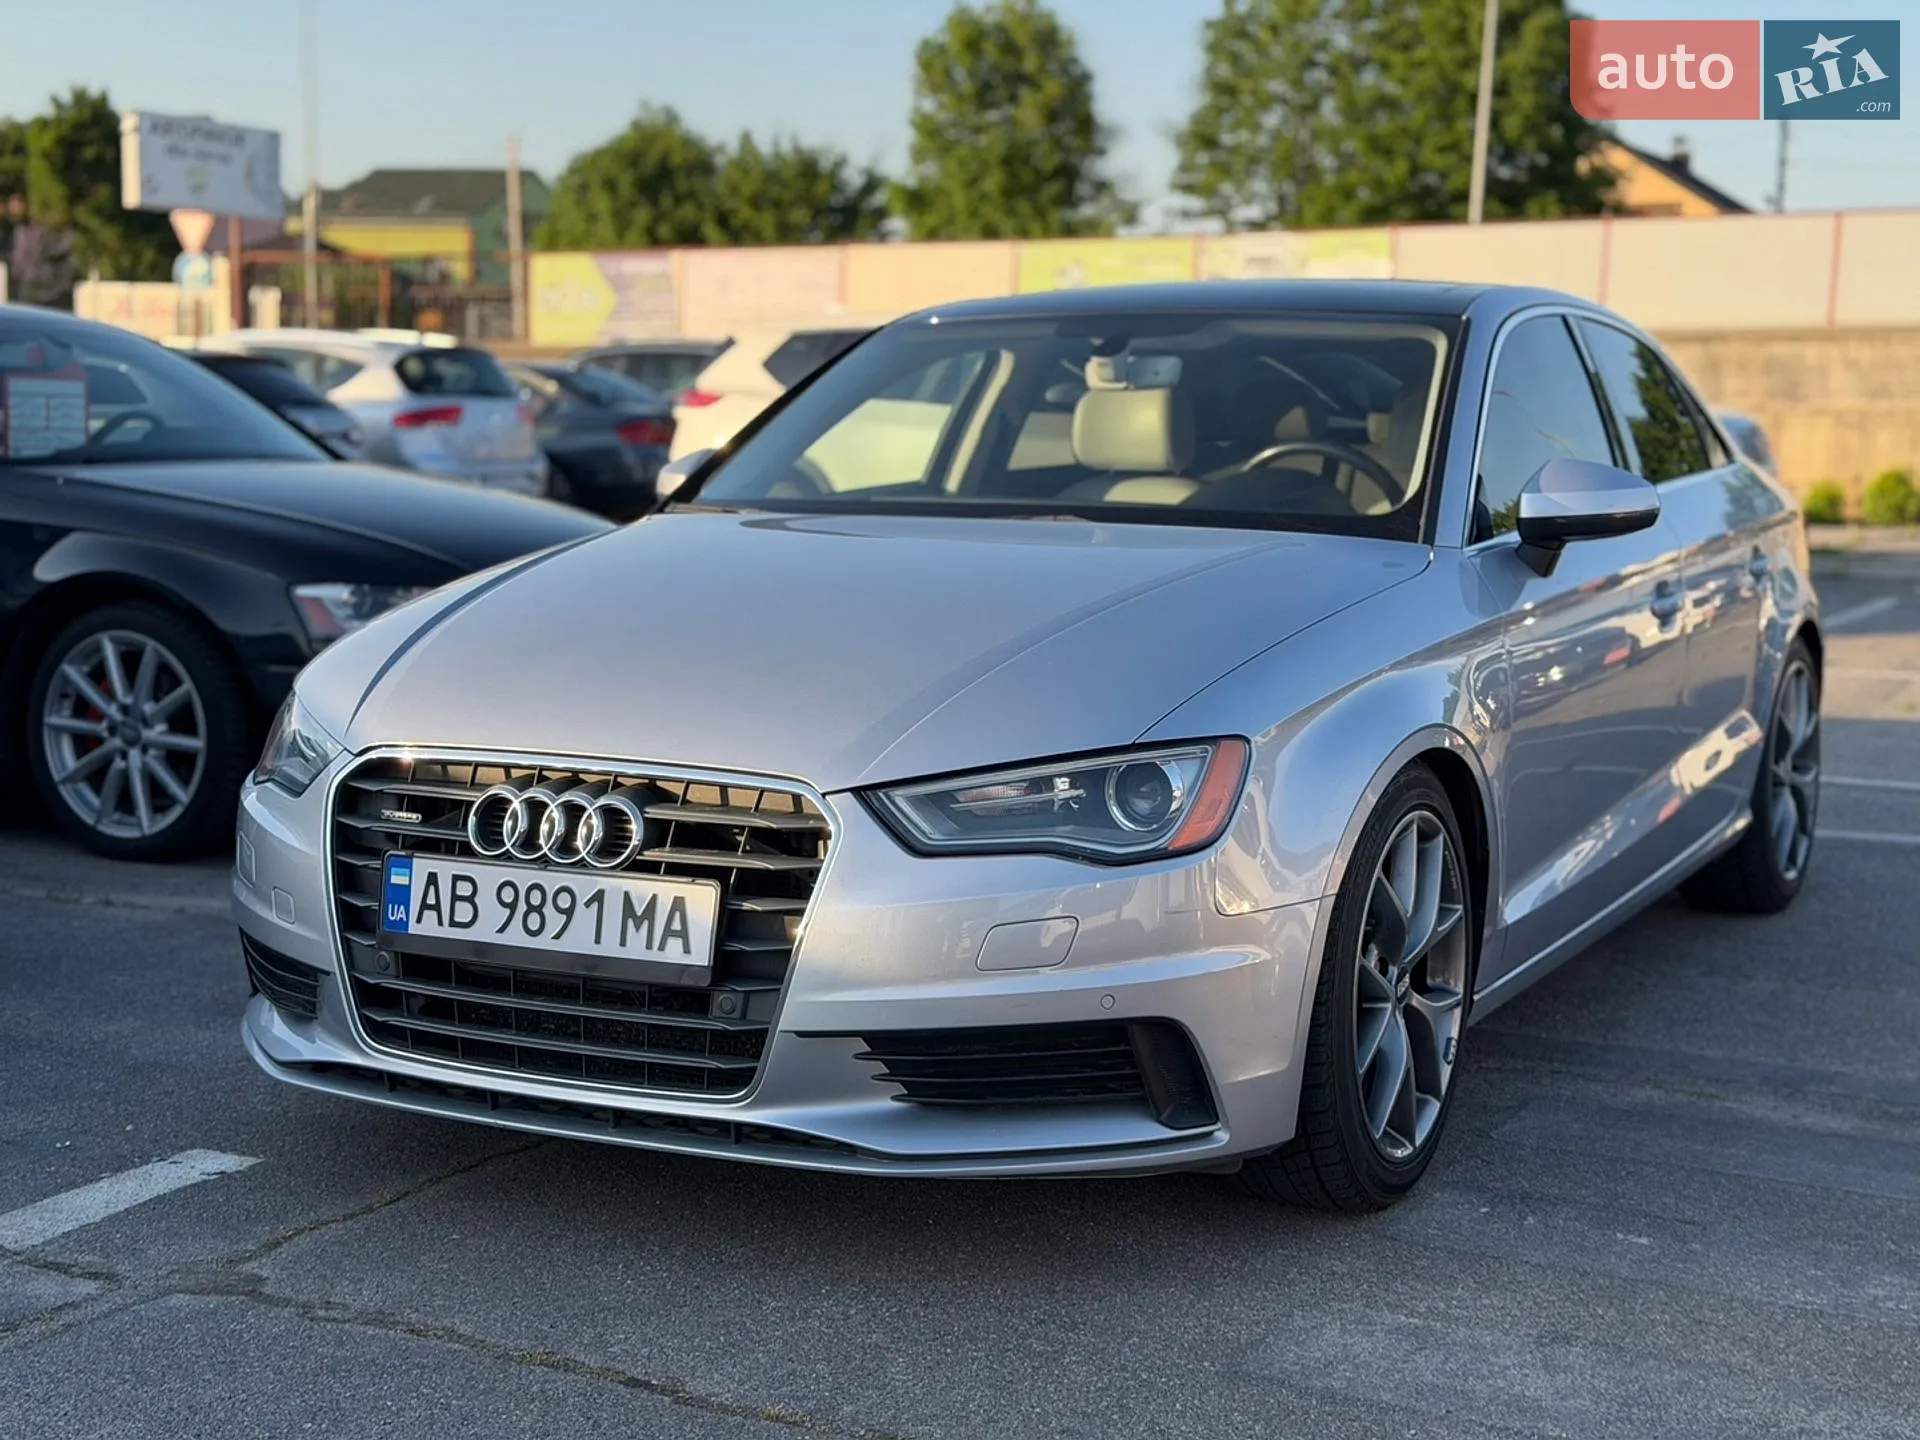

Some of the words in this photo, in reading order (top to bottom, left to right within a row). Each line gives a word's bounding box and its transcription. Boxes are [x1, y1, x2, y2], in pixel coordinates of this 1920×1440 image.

[388, 904, 407, 921] UA
[415, 871, 480, 930] AB
[495, 879, 606, 945] 9891
[619, 890, 692, 955] MA
